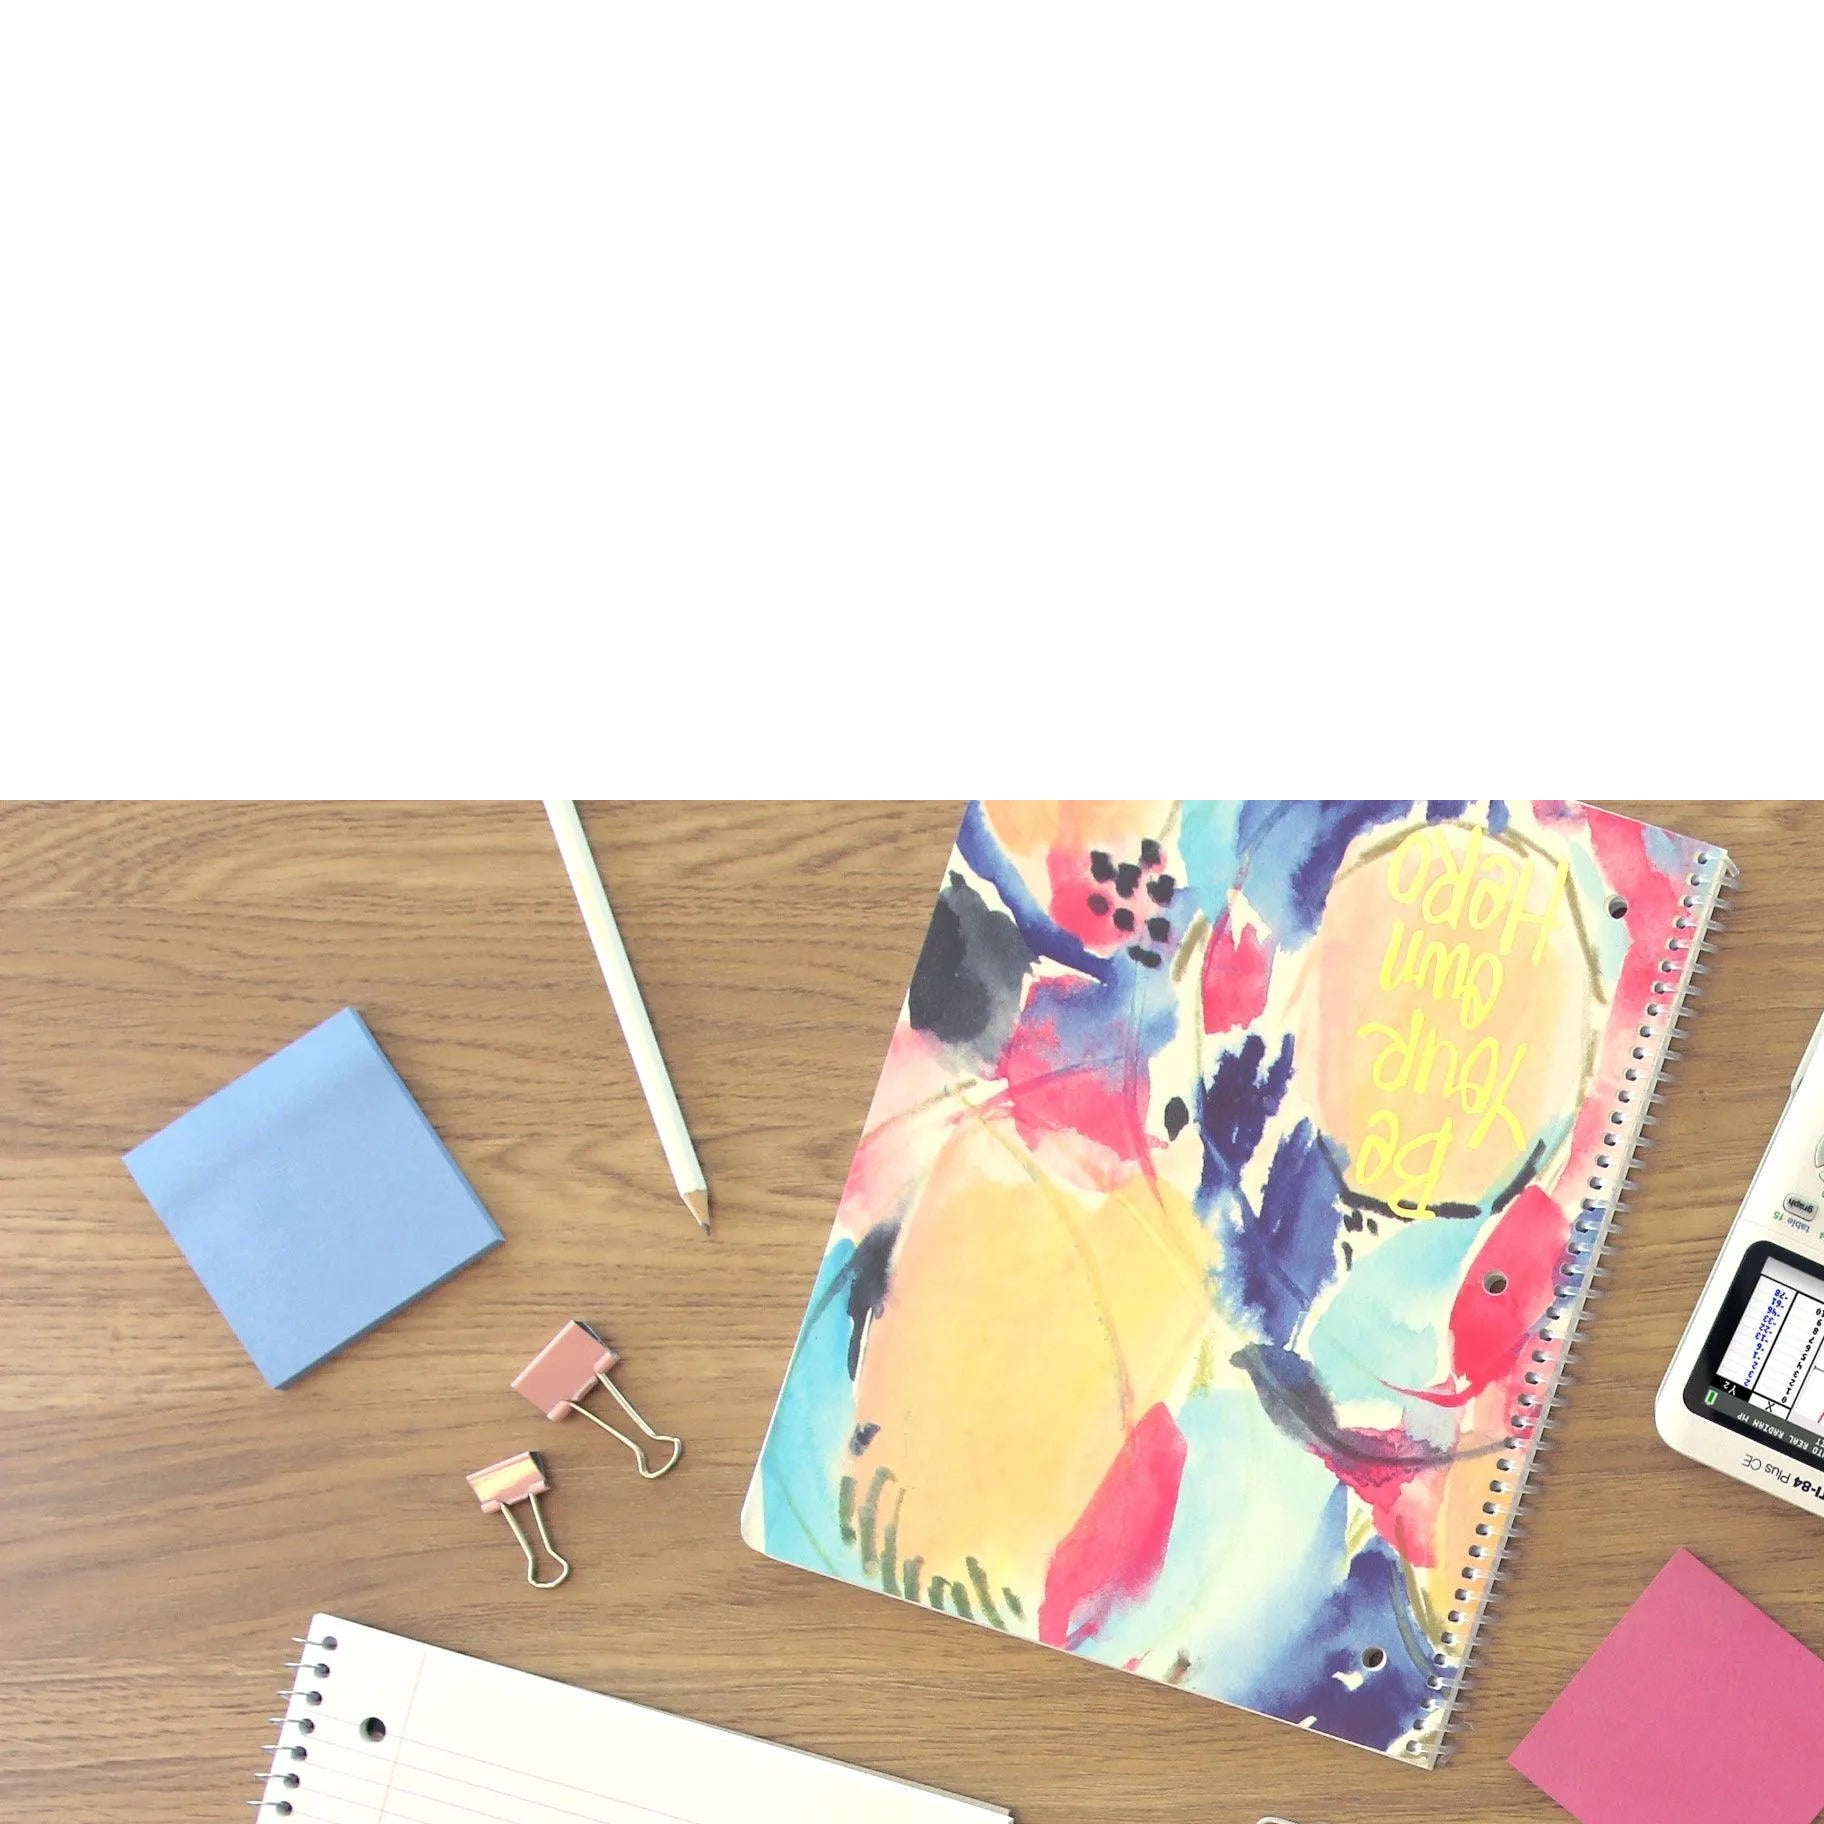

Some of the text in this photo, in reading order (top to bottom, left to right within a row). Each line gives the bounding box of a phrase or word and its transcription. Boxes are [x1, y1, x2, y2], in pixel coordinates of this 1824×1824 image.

[1788, 1196, 1813, 1213] graph
[1773, 1210, 1809, 1232] table f5
[1736, 1412, 1749, 1422] MP
[1752, 1418, 1784, 1438] RADIAN
[1789, 1434, 1808, 1449] REAL
[1741, 1453, 1761, 1470] CE
[1764, 1463, 1791, 1483] Plus
